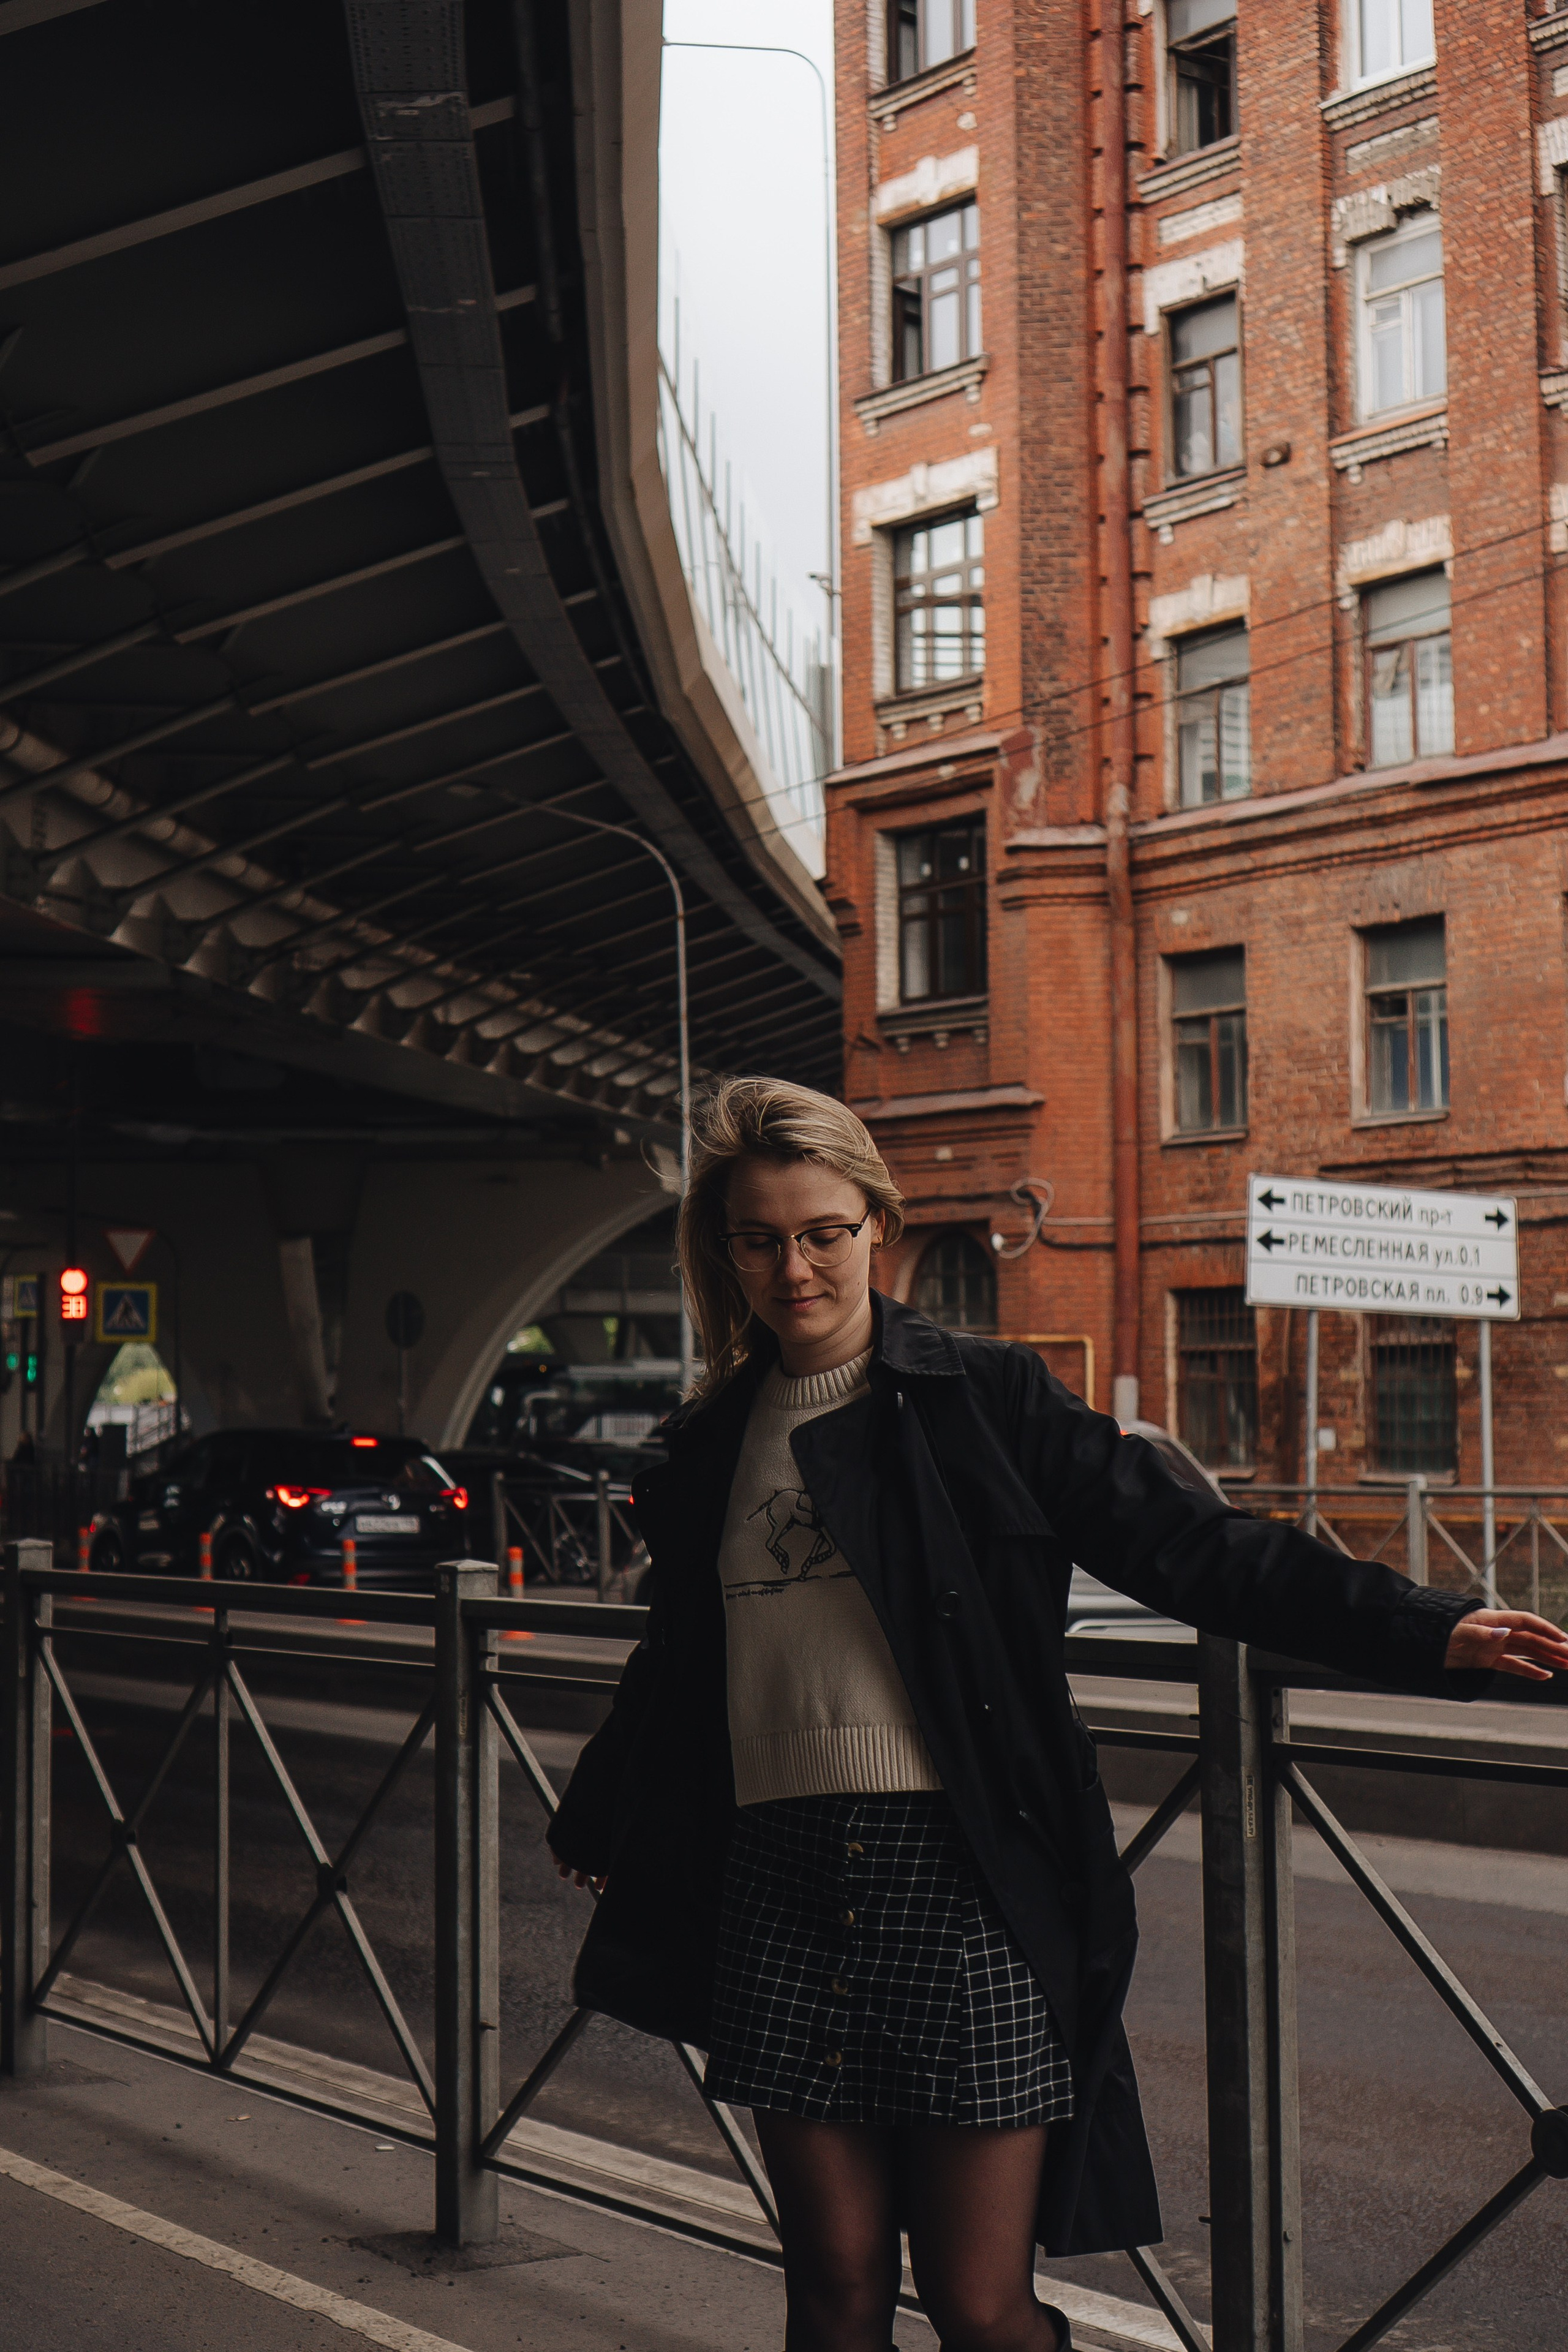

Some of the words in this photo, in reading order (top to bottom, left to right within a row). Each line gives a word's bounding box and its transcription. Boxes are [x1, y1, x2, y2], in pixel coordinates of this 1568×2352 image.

[1292, 1192, 1413, 1221] ПЕТРОВСКИЙ
[1289, 1232, 1429, 1262] РЕМЕСЛЕННАЯ
[1297, 1273, 1420, 1301] ПЕТРОВСКАЯ
